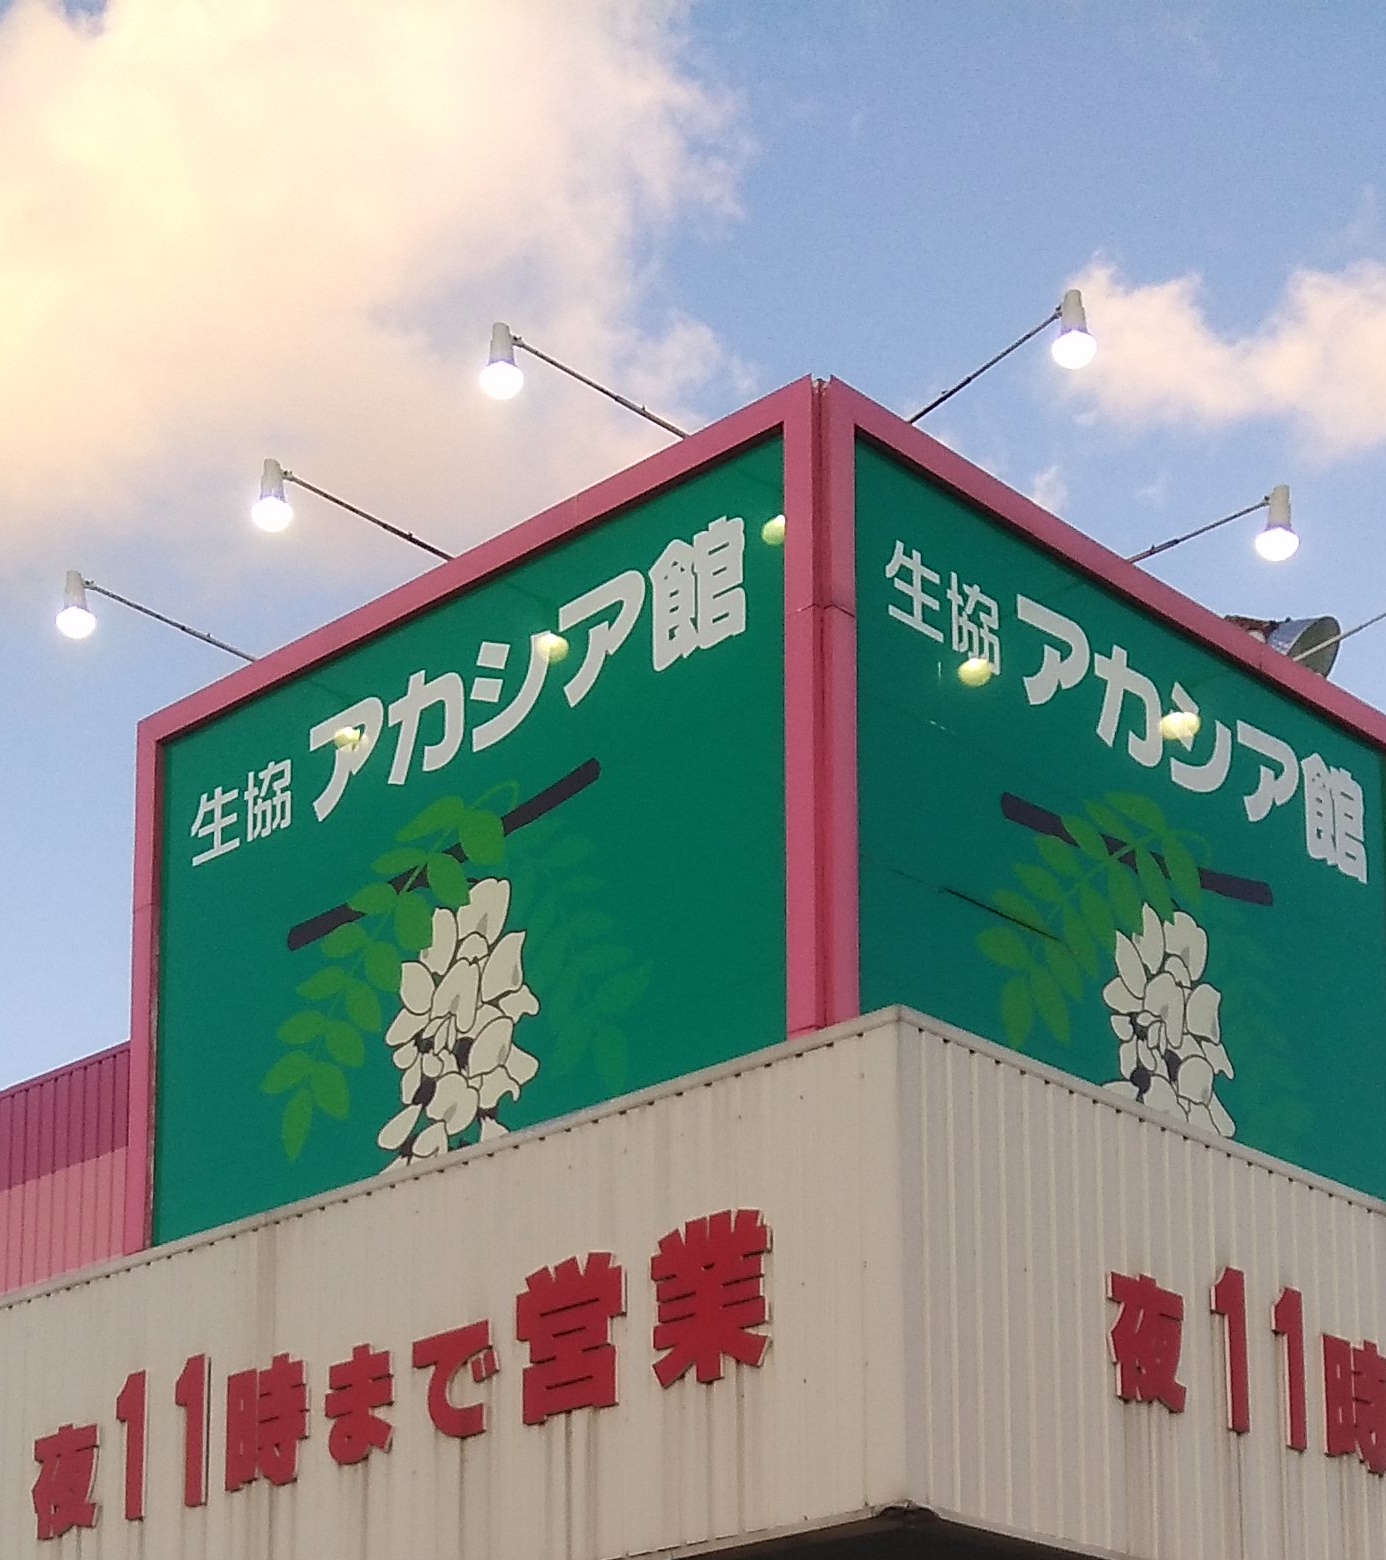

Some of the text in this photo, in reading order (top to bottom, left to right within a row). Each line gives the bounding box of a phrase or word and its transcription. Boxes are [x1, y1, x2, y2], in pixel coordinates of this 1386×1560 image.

[190, 514, 747, 868] 生協 アカシア館
[884, 538, 1370, 885] 生協 アカシア館
[30, 1207, 774, 1542] 夜11時まで営業
